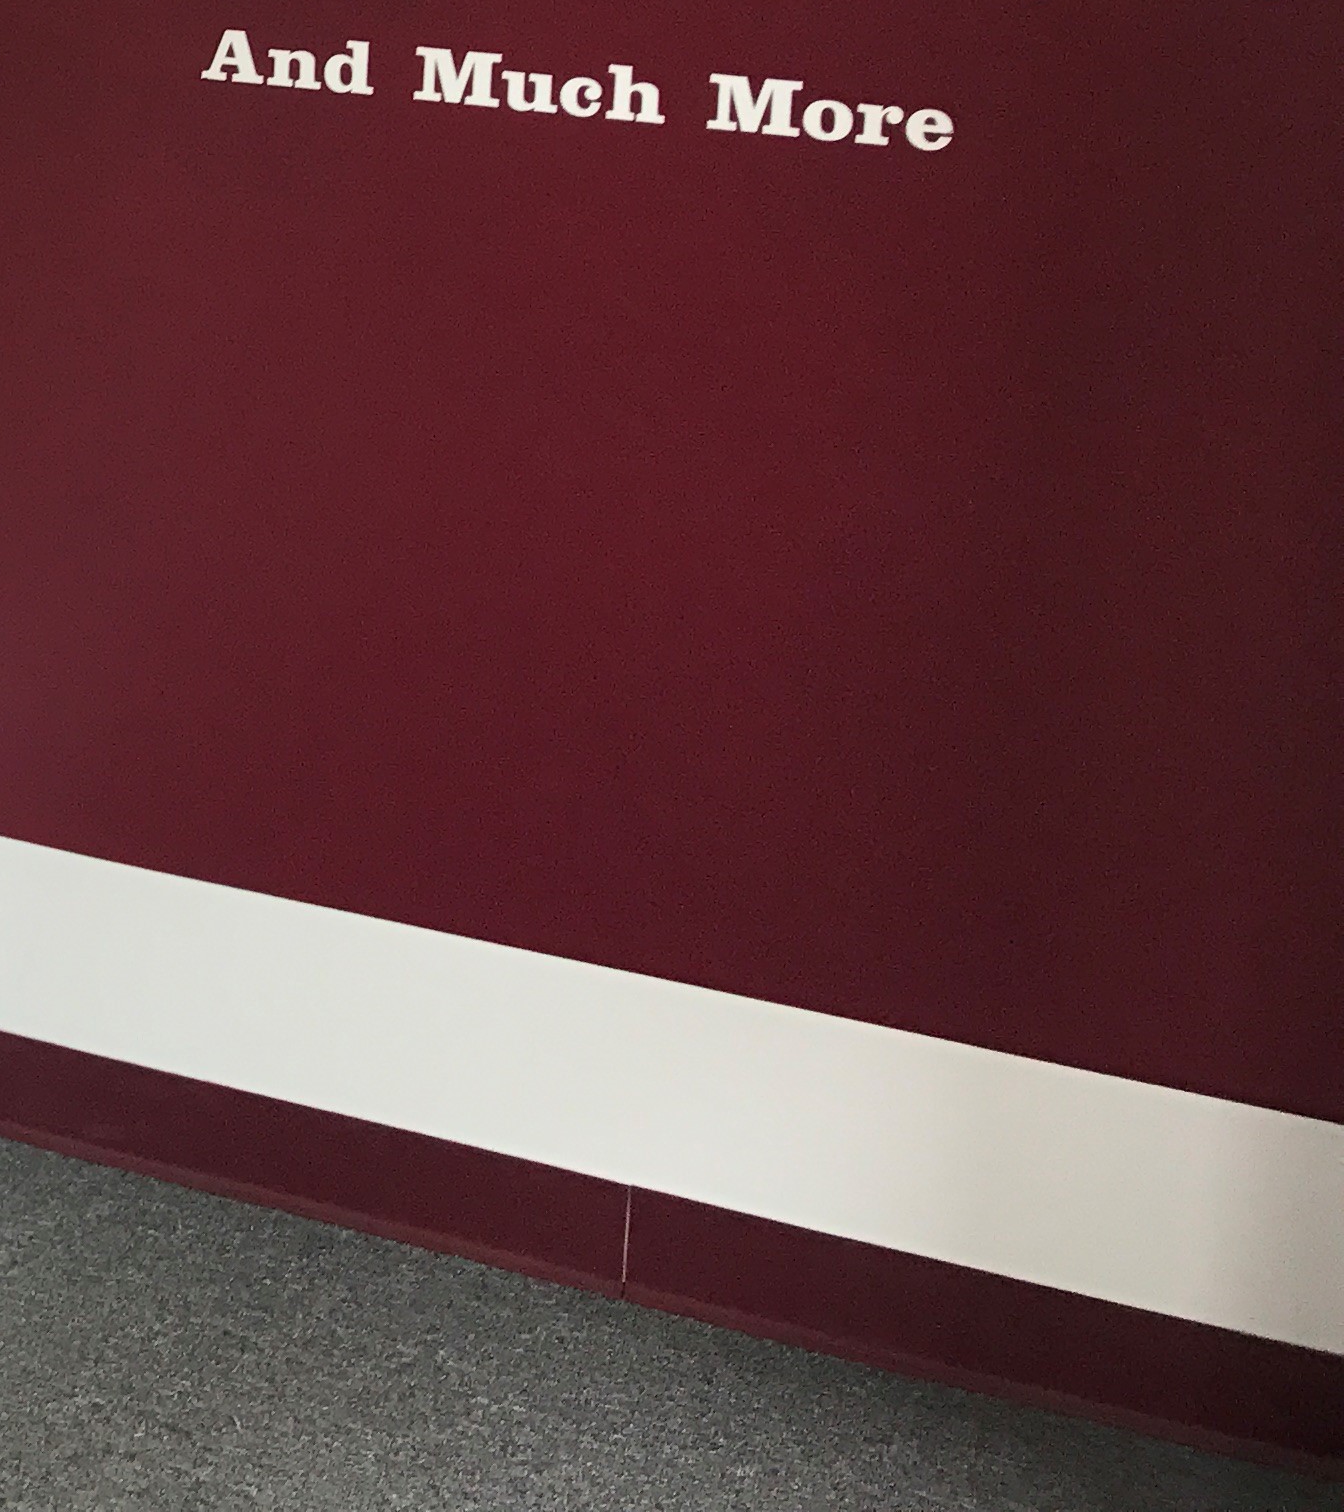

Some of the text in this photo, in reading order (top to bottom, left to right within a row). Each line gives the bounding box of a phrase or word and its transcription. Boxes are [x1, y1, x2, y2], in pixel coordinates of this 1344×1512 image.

[199, 28, 955, 153] And Much More
